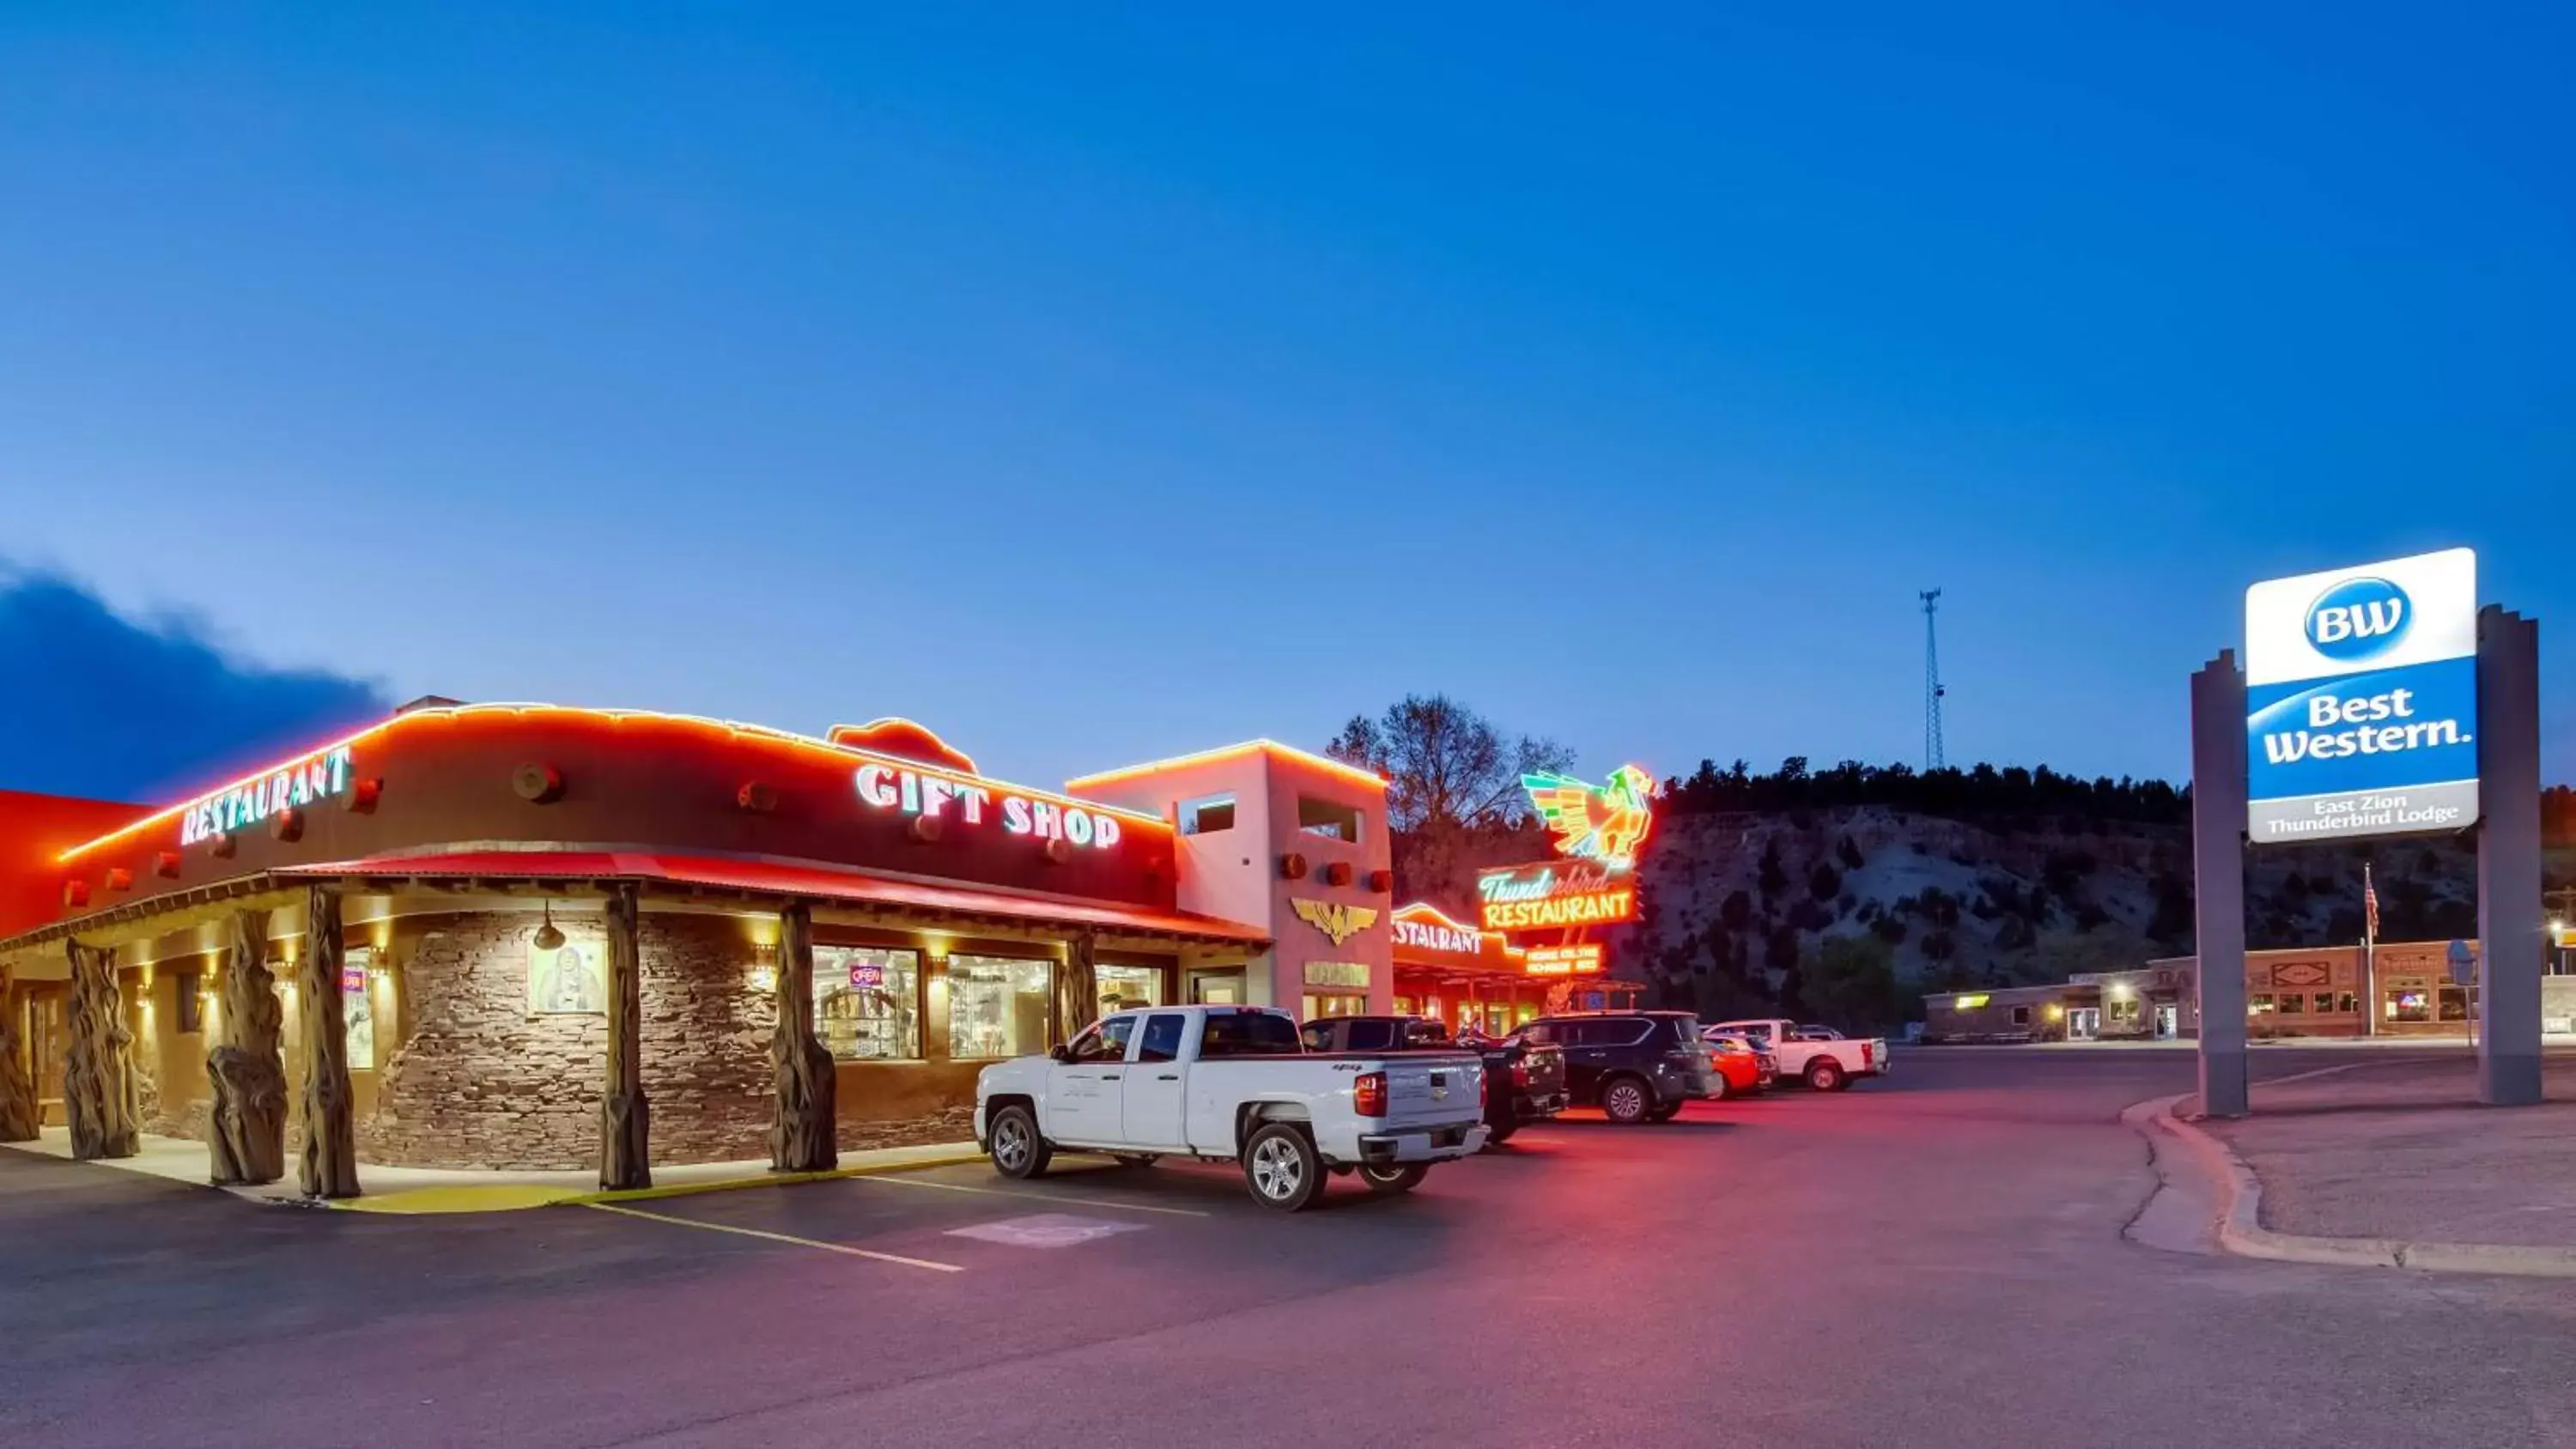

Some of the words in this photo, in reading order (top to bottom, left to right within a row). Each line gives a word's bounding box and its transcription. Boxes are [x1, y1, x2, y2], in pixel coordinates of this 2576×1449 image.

[2317, 597, 2402, 643] BW
[2309, 688, 2415, 727] Best
[181, 744, 351, 846] RESTAURANT
[855, 763, 990, 825] GIFT
[1002, 796, 1121, 849] SHOP
[2314, 799, 2354, 815] East
[2360, 794, 2407, 811] Zion
[2267, 808, 2391, 834] Thunderbird
[2397, 805, 2459, 825] Lodge
[1479, 864, 1610, 902] Thunderbird
[1484, 892, 1630, 928] RESTAURANT
[853, 969, 880, 982] OPEN
